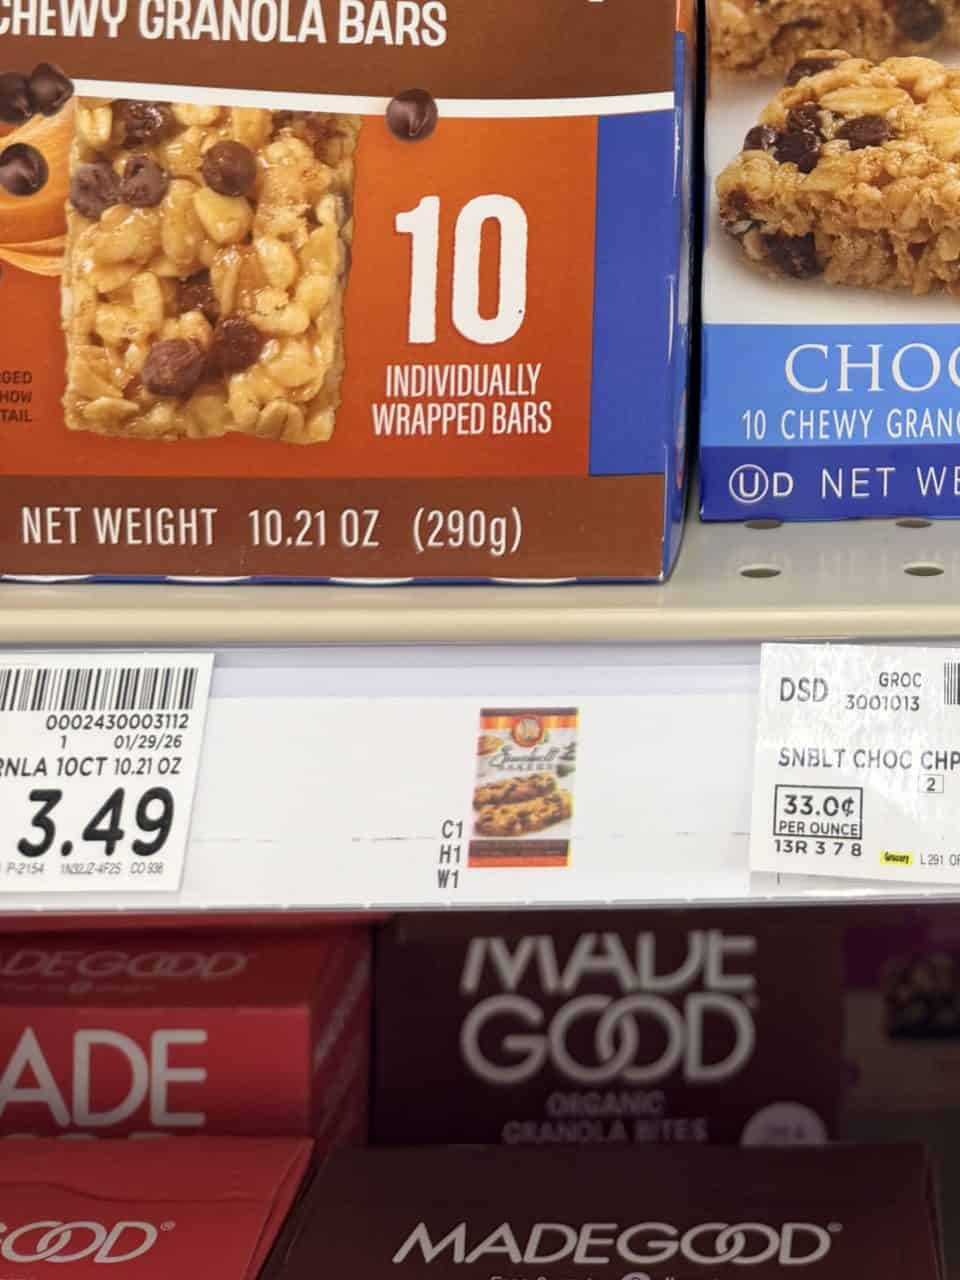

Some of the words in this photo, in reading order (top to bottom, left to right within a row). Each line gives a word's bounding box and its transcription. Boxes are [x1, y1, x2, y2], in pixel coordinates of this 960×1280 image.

[394, 192, 530, 346] 10
[384, 362, 543, 397] INDIVIDUALLY
[372, 400, 487, 436] WRAPPED
[491, 400, 553, 435] BARS
[741, 408, 768, 441] 10
[780, 407, 875, 440] CHEWY
[820, 465, 897, 498] NET
[22, 507, 81, 546] NET
[94, 507, 218, 547] WEIGHT
[248, 509, 329, 548] 10.21
[340, 509, 381, 548] OZ
[412, 506, 523, 554] (290g)
[779, 677, 829, 703] DSD
[878, 671, 923, 689] GROC
[845, 694, 921, 713] 3001013
[46, 713, 190, 731] 0002430003112
[60, 735, 68, 750] 1
[114, 734, 183, 751] 01/29/26
[56, 756, 108, 777] 10CT
[114, 757, 153, 776] 10.21
[157, 757, 182, 776] OZ
[778, 746, 845, 770] SNBLT
[852, 748, 912, 770] CHOC
[925, 777, 937, 792] 2
[783, 794, 855, 818] 33.0¢
[17, 786, 175, 858] 3.49
[442, 819, 463, 839] C1
[778, 820, 806, 835] PER
[809, 821, 859, 837] OUNCE
[439, 844, 461, 864] H1
[774, 839, 808, 856] 13R
[815, 841, 826, 856] 3
[833, 842, 844, 856] 7
[850, 842, 862, 857] 8
[437, 869, 459, 889] W1
[461, 929, 758, 995] MADE
[460, 994, 757, 1085] GOOD
[545, 1090, 665, 1116] ORGANIC
[392, 1221, 832, 1265] MADEGOOD
